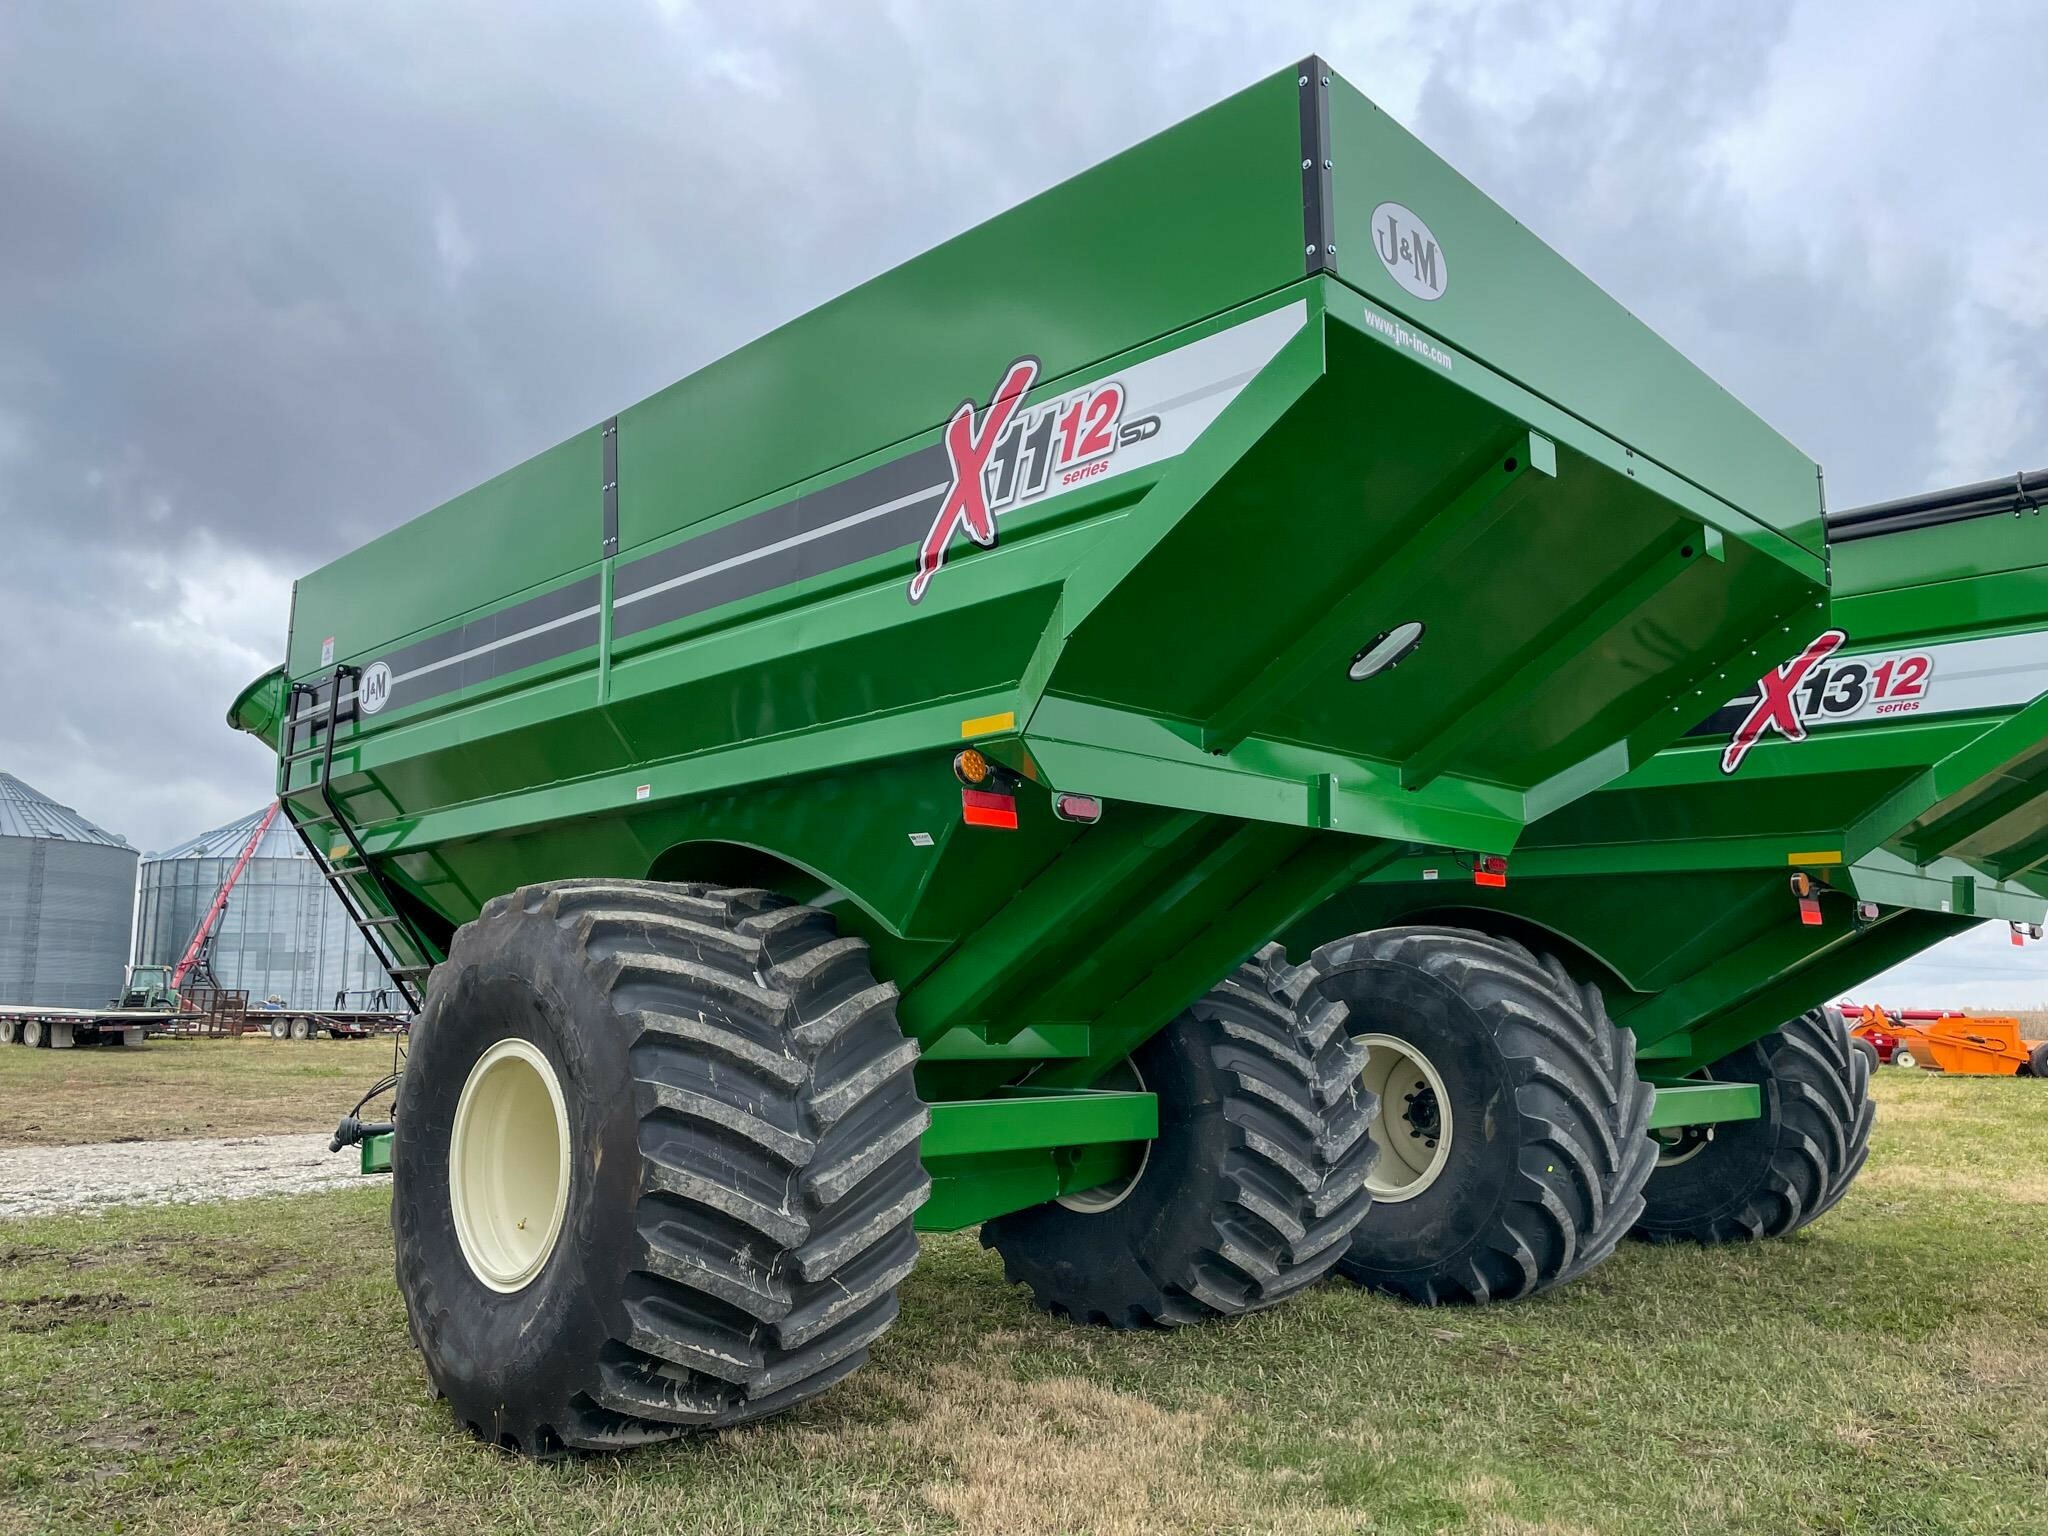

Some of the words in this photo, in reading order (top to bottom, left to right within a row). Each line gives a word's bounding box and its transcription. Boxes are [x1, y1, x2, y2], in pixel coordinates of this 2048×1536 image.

[1377, 214, 1438, 291] J&M
[1364, 307, 1452, 370] www.jm-inc.com
[1062, 460, 1109, 486] series
[362, 672, 387, 704] J&M
[1876, 700, 1920, 714] series
